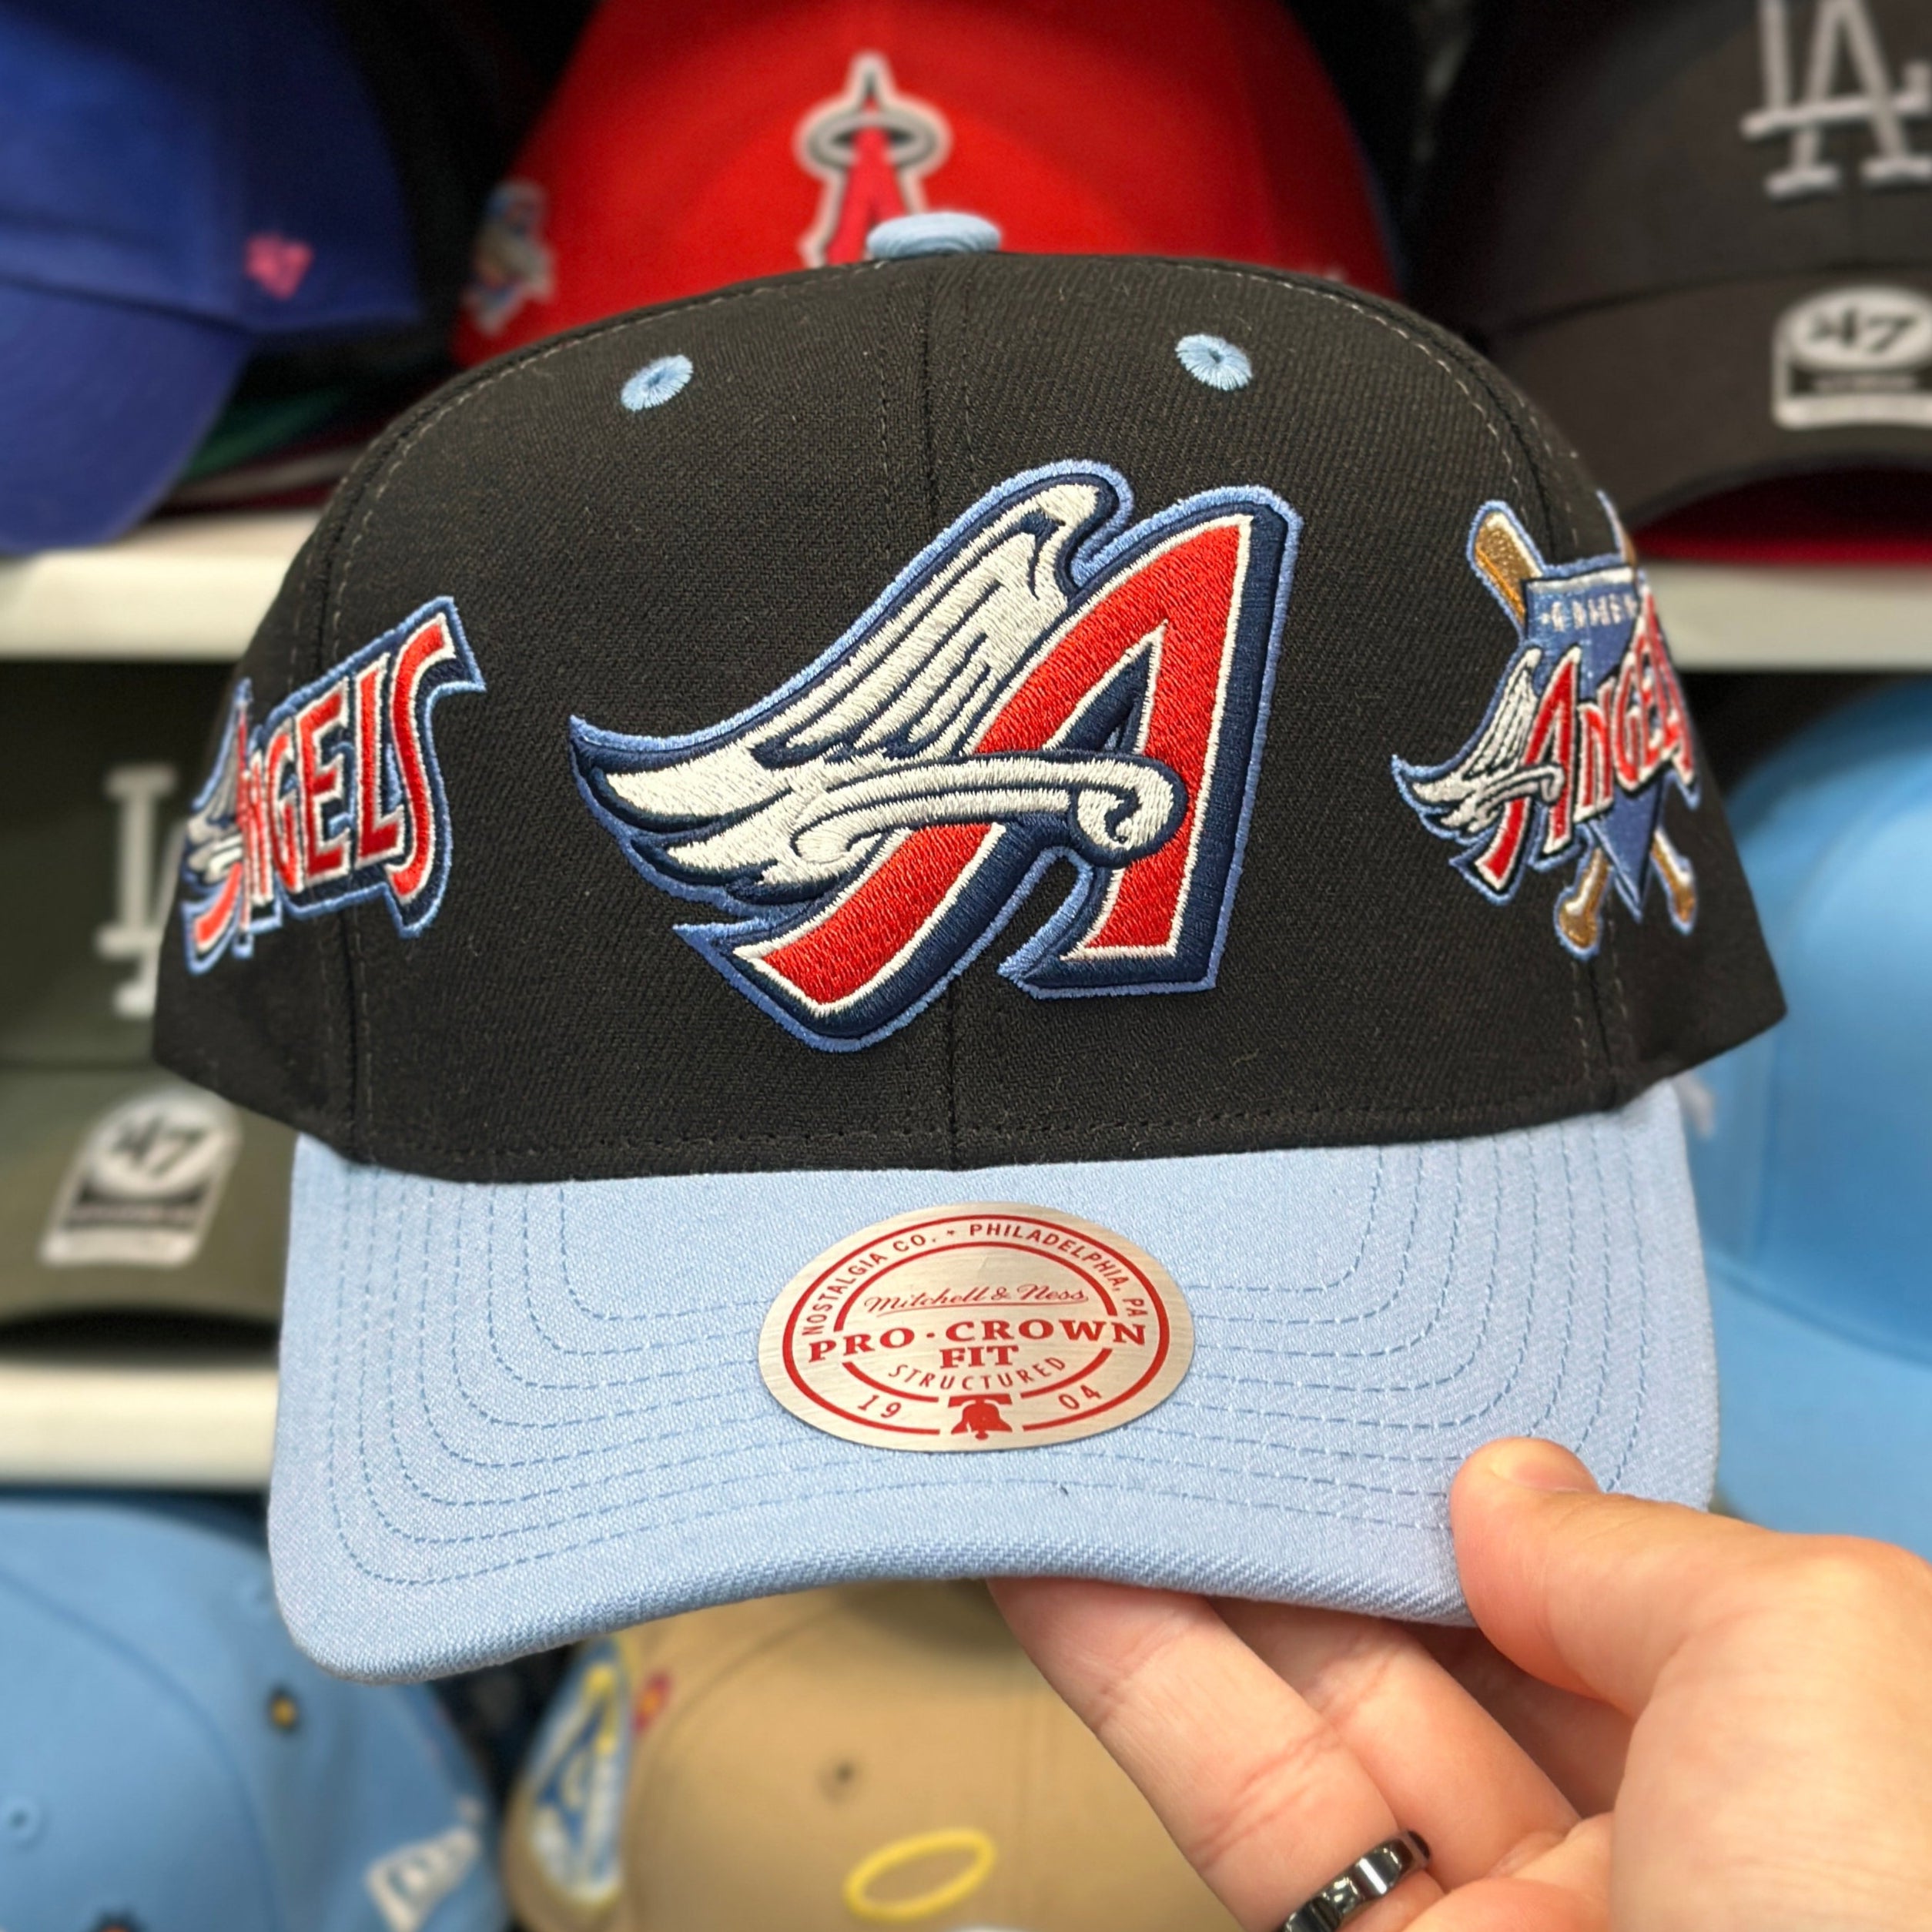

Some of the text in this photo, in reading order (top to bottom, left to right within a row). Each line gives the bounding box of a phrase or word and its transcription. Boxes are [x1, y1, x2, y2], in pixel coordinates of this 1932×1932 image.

[1742, 0, 1932, 197] LA
[802, 1223, 1148, 1336] NOSTALGIA CO. PHILADELPHIA, PA
[863, 1283, 1089, 1313] Mitchell & Ness
[888, 1356, 1066, 1391] STRUCTURED
[939, 1344, 1020, 1369] FIT
[857, 1384, 1103, 1419] 19 04
